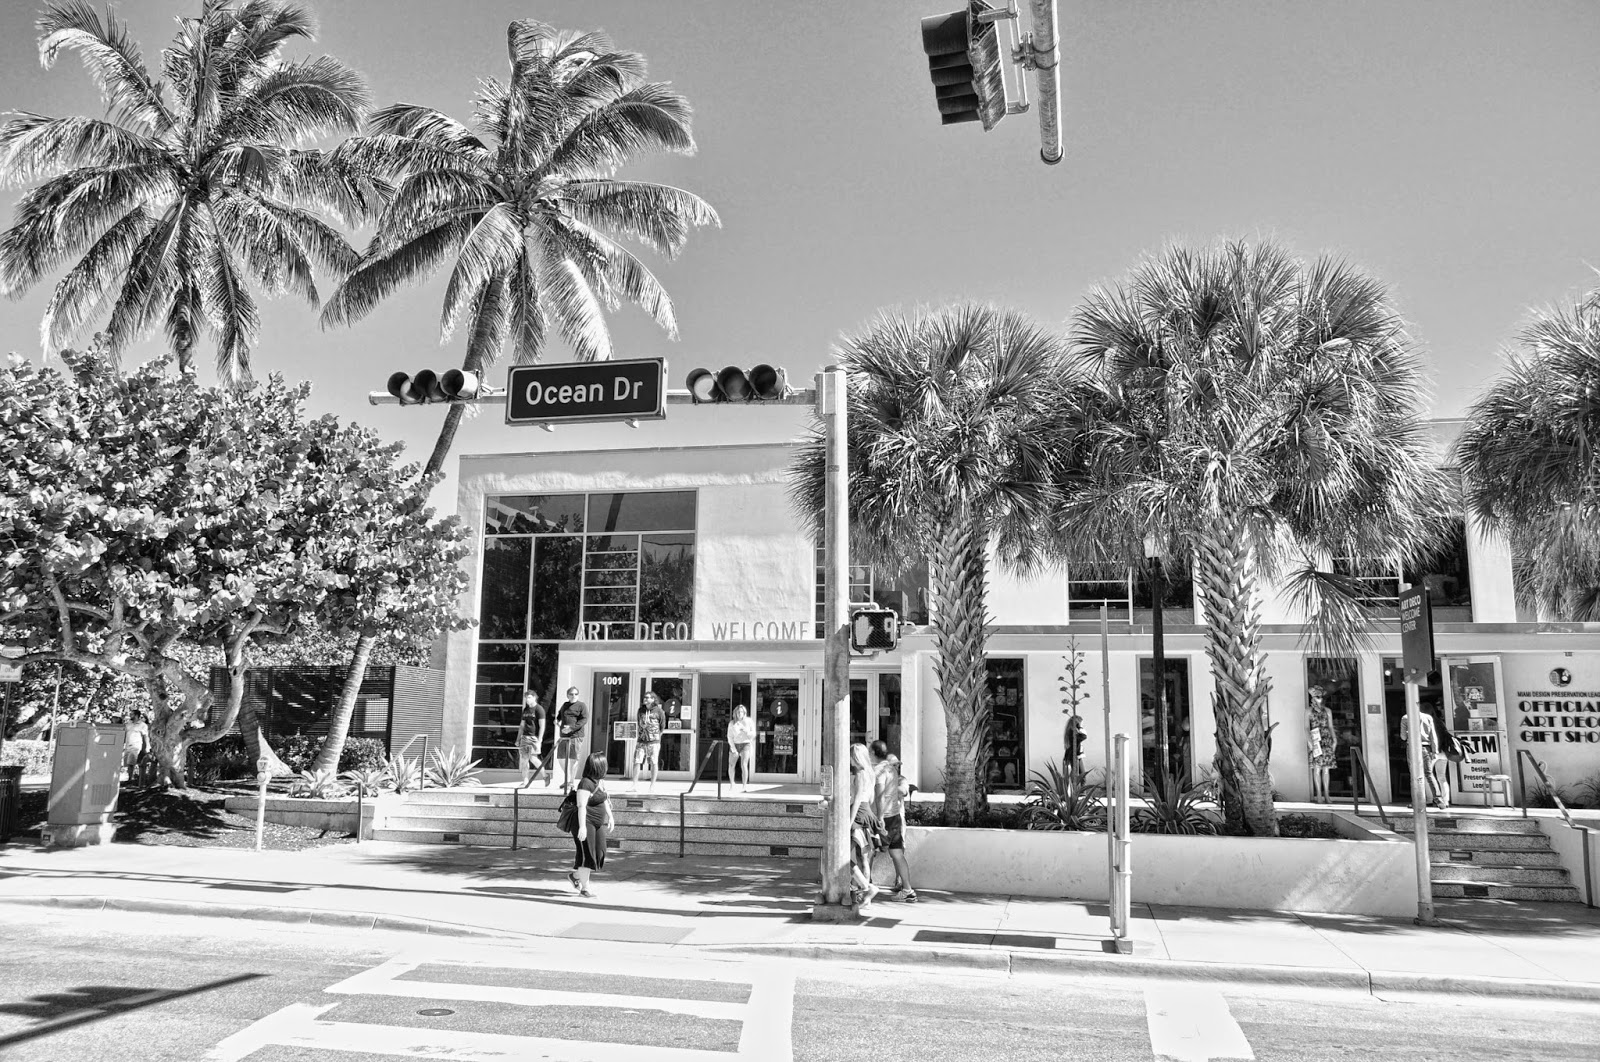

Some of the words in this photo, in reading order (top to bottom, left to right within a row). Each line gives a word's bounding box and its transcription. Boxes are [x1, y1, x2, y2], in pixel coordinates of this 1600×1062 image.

[526, 381, 604, 405] Ocean
[614, 377, 643, 400] Dr
[575, 622, 612, 640] ART
[638, 622, 688, 640] DECO
[712, 621, 809, 640] WELCOME
[602, 676, 622, 685] 1001
[1520, 716, 1557, 727] ART
[1561, 716, 1600, 728] DEC
[1520, 730, 1562, 742] GIFT
[1565, 730, 1600, 743] SHO
